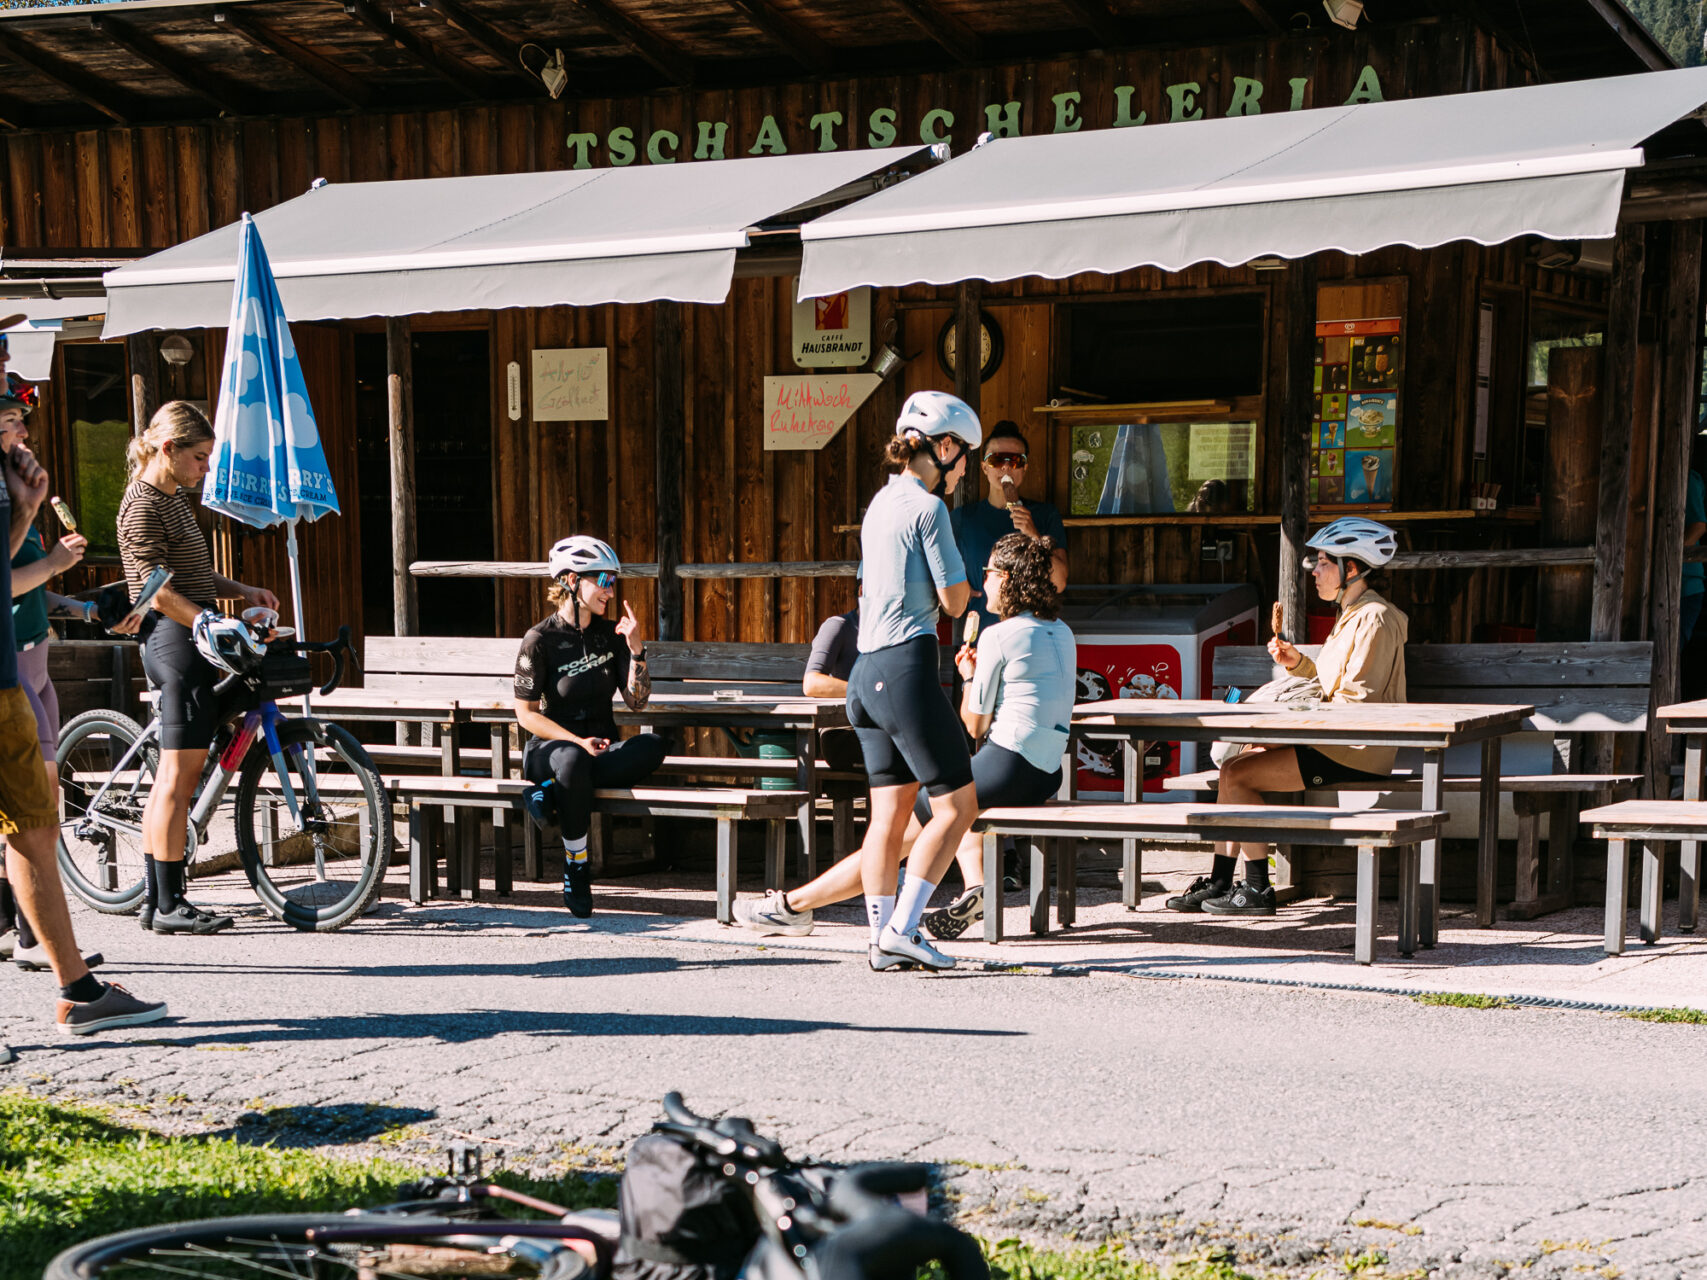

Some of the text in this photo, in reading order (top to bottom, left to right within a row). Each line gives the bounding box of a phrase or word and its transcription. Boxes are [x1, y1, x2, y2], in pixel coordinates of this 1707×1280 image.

[566, 65, 1385, 170] TSCHATSCHELERIA
[801, 342, 863, 353] HAUSBRANDT
[777, 381, 854, 410] Mittwoch
[300, 489, 328, 502] CREAM
